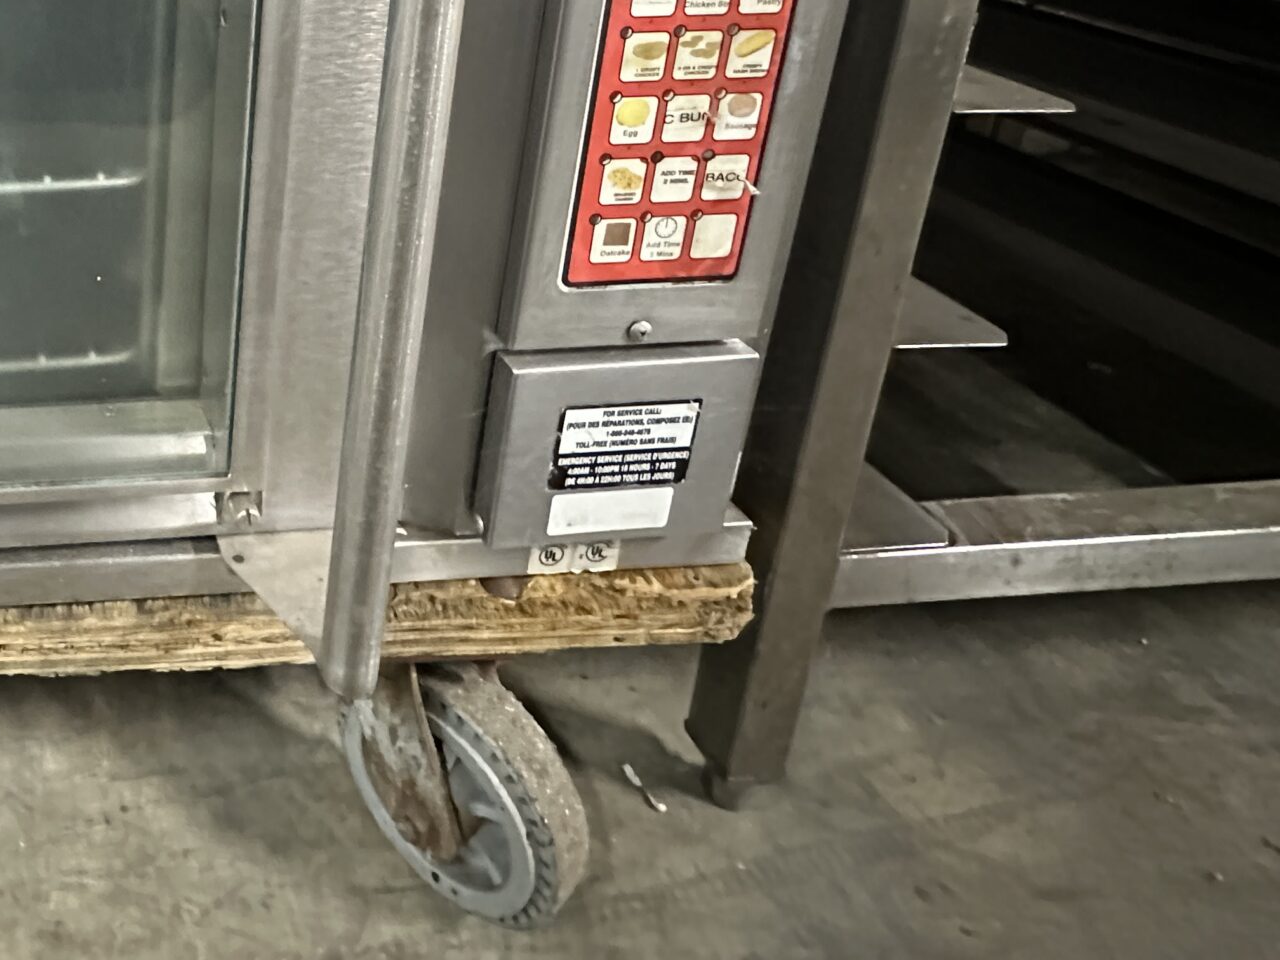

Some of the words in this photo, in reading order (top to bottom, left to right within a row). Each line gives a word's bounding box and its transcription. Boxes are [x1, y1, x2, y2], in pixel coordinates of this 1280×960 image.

[685, 0, 715, 9] Chicken
[623, 129, 638, 138] Egg
[603, 410, 616, 418] FOR
[617, 409, 643, 417] SERVICE
[596, 455, 624, 464] SERVICE
